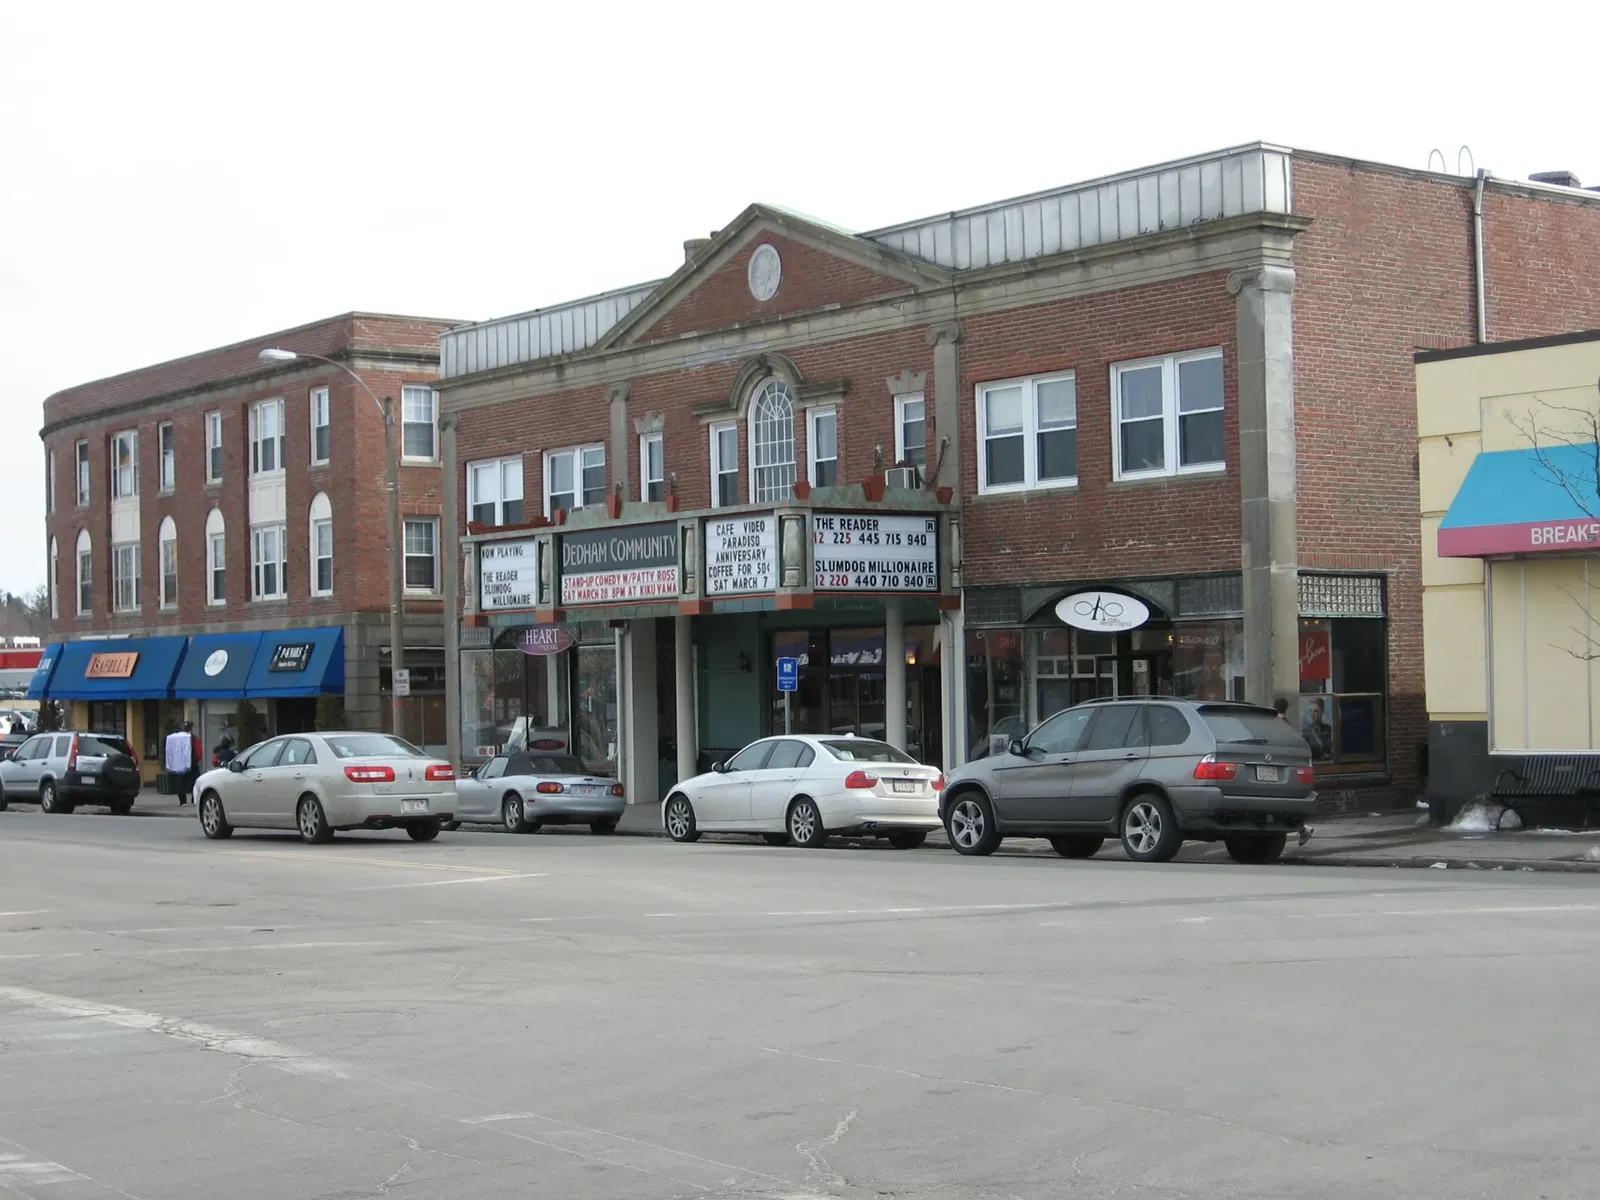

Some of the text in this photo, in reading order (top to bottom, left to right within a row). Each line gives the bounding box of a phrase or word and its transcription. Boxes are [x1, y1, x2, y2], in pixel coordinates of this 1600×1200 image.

[716, 520, 765, 536] CAFE VIDEO
[816, 518, 834, 530] THE
[840, 518, 879, 531] READER
[723, 535, 760, 549] PARADISO
[813, 532, 927, 546] 12 225 445 715 940
[481, 545, 523, 559] NOW PLAYING
[563, 541, 607, 567] DEDHAM
[716, 548, 766, 563] ANNIVERSARY
[709, 565, 733, 578] COFFEE
[738, 563, 752, 575] FOR
[815, 560, 934, 573] SLUMDOG MILLIONAIRE
[483, 570, 518, 582] THE READER
[595, 574, 620, 587] COMEDY
[657, 569, 675, 581] ROSS
[714, 576, 768, 591] SAT MARCH 7
[815, 575, 825, 586] 12
[830, 575, 848, 587] 220
[855, 575, 877, 587] 440
[881, 575, 899, 587] 710
[904, 575, 924, 587] 940
[564, 590, 575, 601] SAT
[577, 588, 598, 600] MARCH
[600, 588, 608, 599] 28
[612, 586, 625, 597] 8PM
[628, 585, 637, 596] AT
[525, 628, 559, 645] HEART
